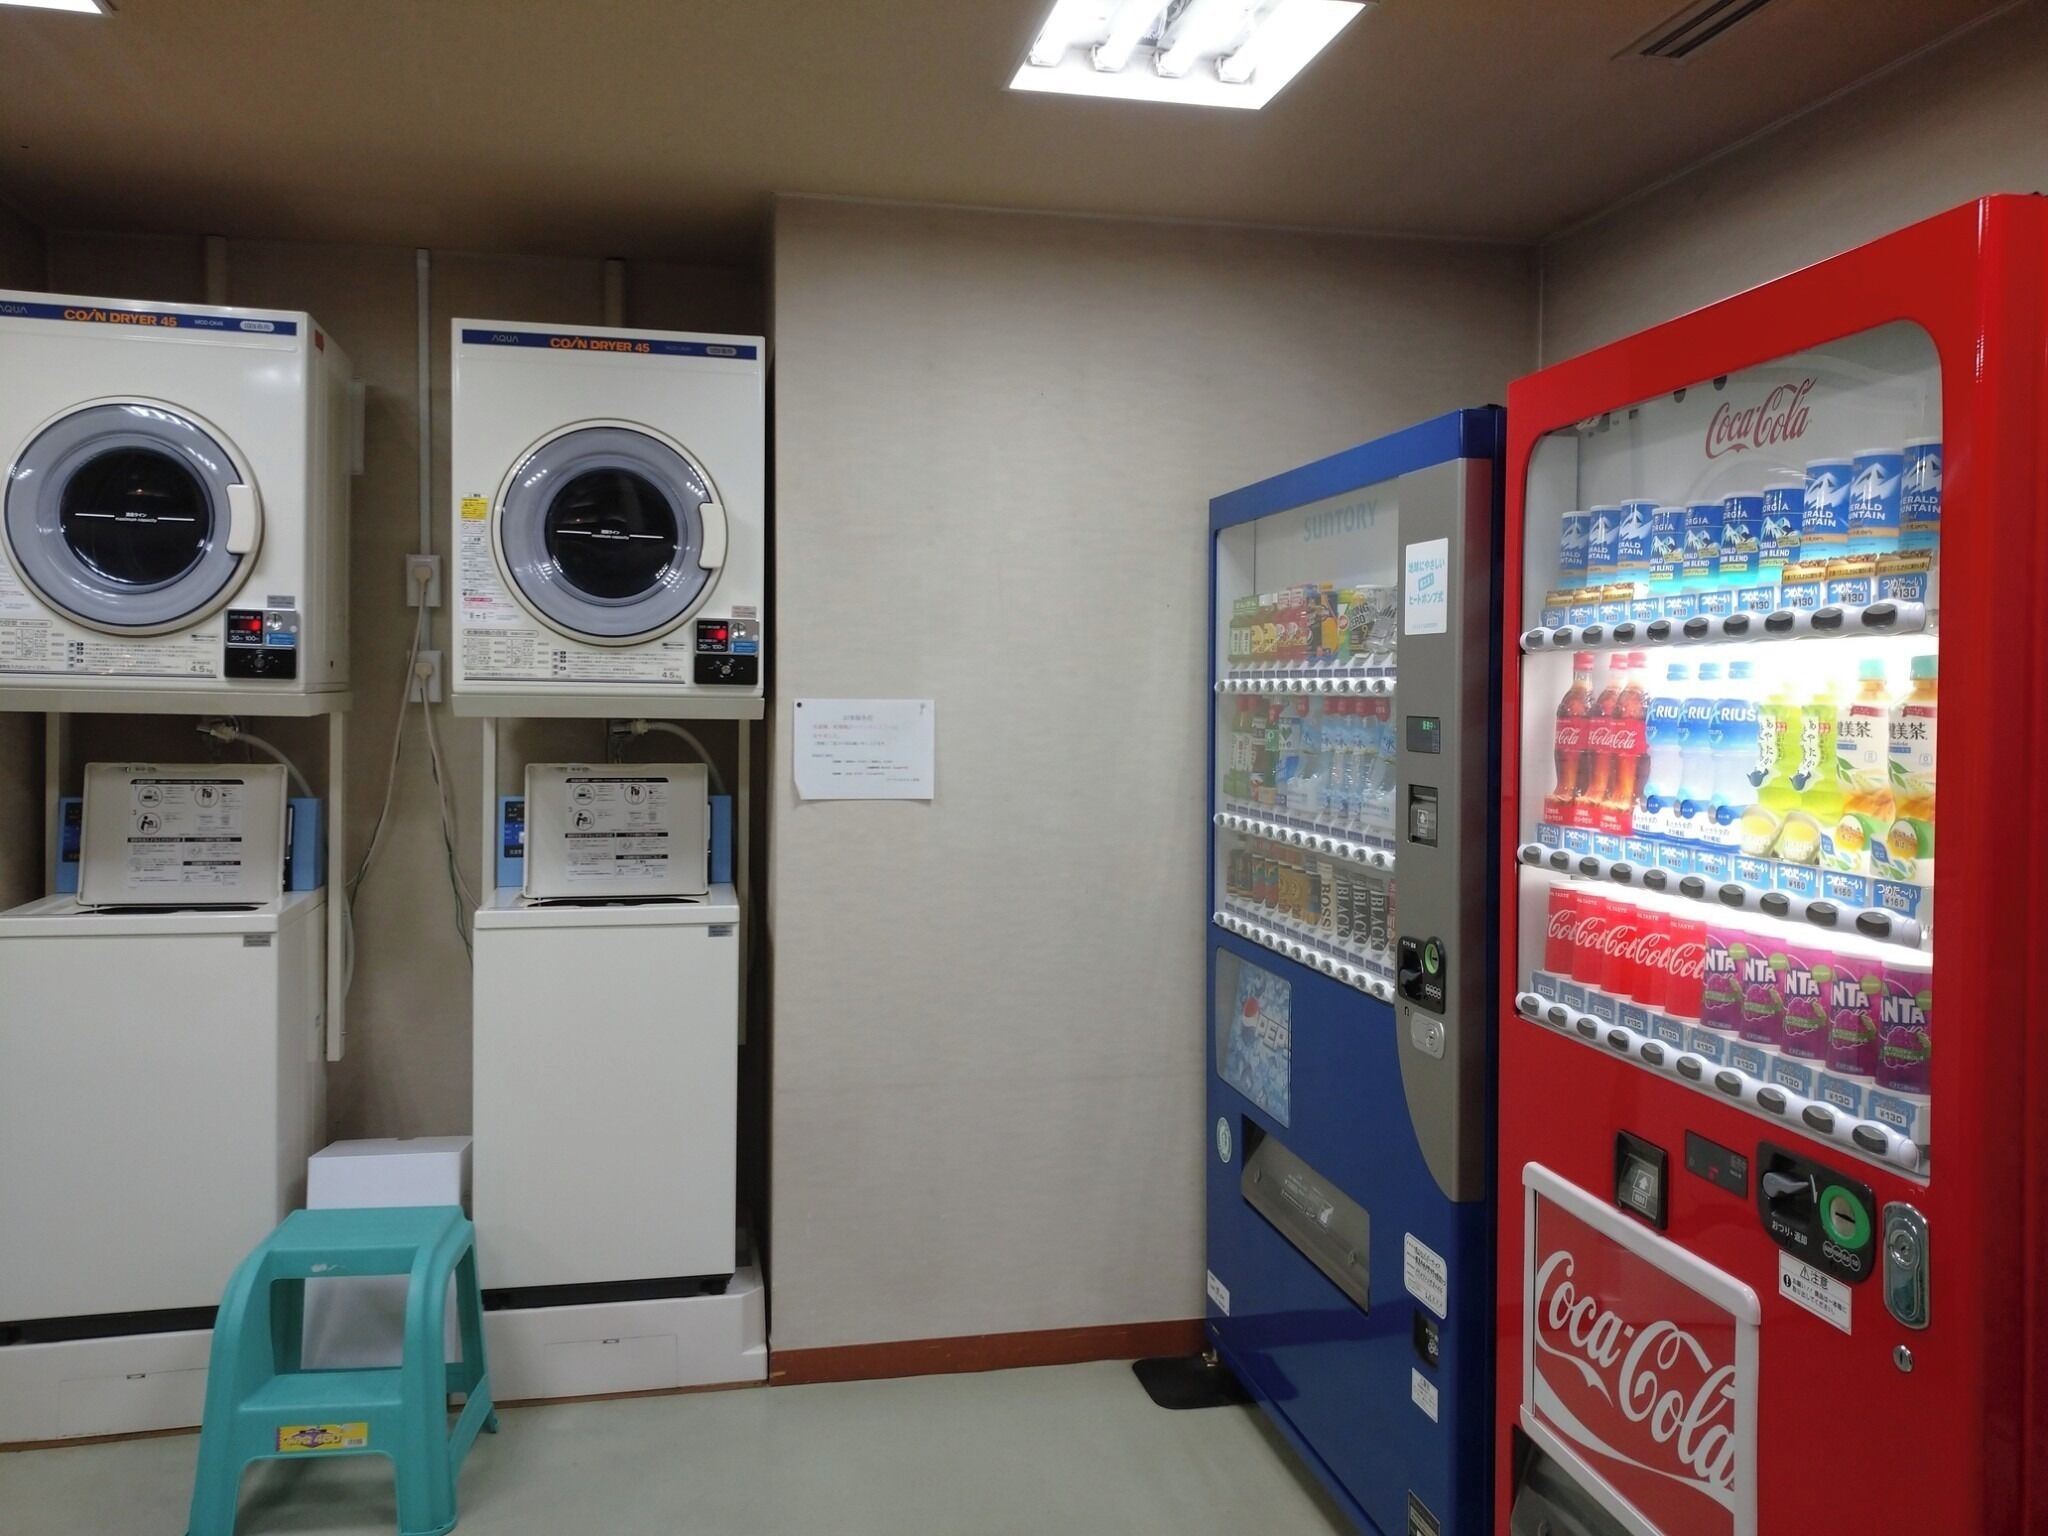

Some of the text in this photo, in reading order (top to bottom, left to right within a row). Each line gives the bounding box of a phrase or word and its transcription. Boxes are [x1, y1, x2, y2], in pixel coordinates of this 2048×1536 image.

[109, 313, 157, 326] DRYER
[160, 316, 177, 327] 45
[590, 339, 632, 352] DRYER
[635, 343, 650, 353] 45
[1705, 376, 1817, 459] Coca-Cola
[1302, 500, 1378, 543] SUNTORY
[1750, 600, 1770, 610] ¥130
[1791, 597, 1813, 608] ¥130
[1841, 592, 1864, 604] ¥130
[1892, 587, 1917, 599] ¥130
[1320, 883, 1332, 928] BOSS
[1337, 885, 1350, 938] BLACK
[1885, 896, 1905, 908] ¥160
[1353, 890, 1367, 945] BLACK
[1370, 895, 1385, 951] BLACK
[1705, 947, 1736, 972] NTA
[1744, 957, 1776, 982] NTA
[1784, 969, 1820, 996] NTA
[1830, 980, 1869, 1008] NTA
[1880, 995, 1925, 1024] NTA
[1780, 1075, 1799, 1089] ¥130
[1829, 1093, 1850, 1105] ¥130
[1880, 1110, 1903, 1124] ¥130
[1535, 1250, 1736, 1490] Coca-Cola
